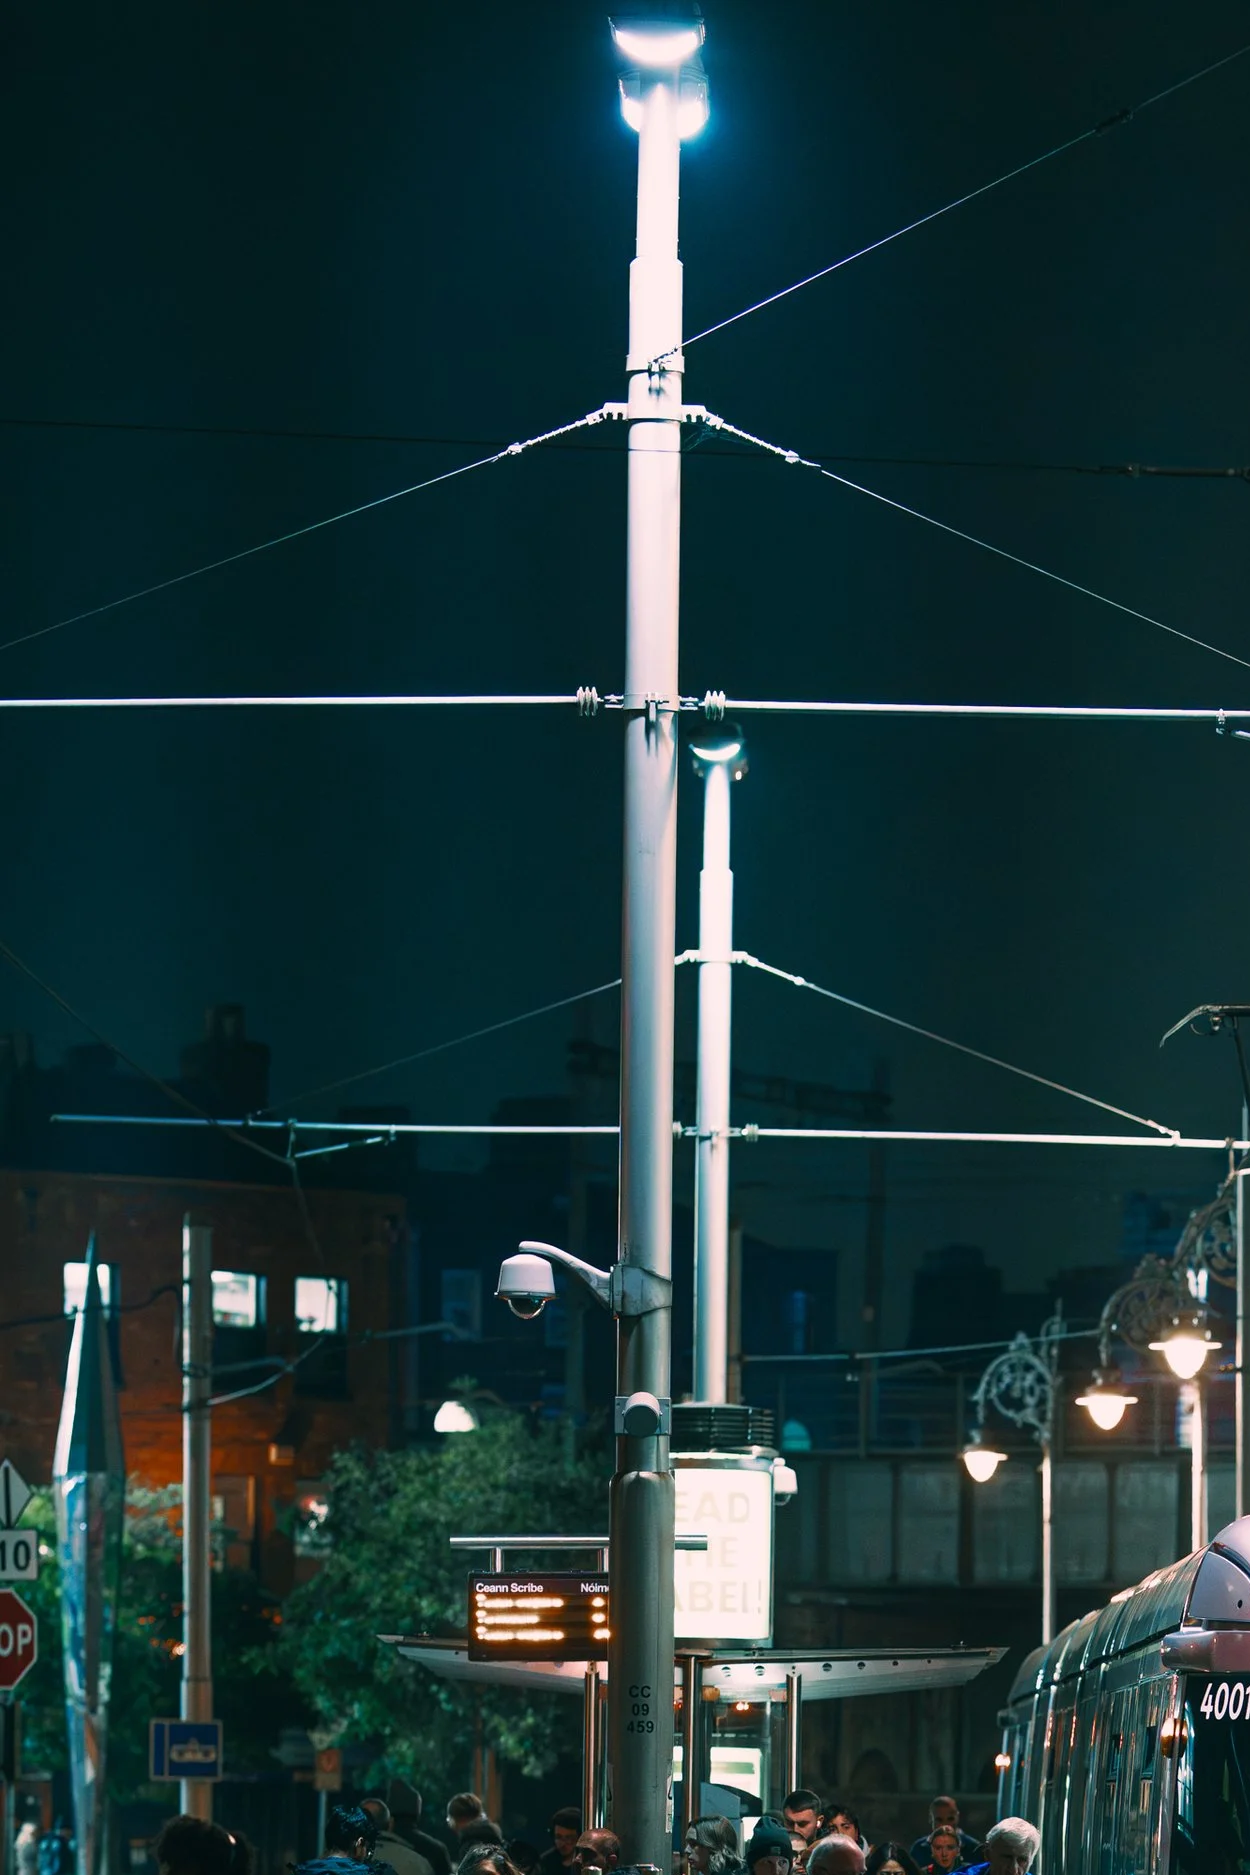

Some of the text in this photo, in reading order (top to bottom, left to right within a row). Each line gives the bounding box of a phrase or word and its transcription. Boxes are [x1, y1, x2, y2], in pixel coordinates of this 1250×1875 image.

[674, 1490, 751, 1524] EAD
[684, 1536, 739, 1568] HE
[475, 1583, 508, 1593] Ceann
[580, 1582, 609, 1593] Nóim
[674, 1579, 763, 1615] BEL!
[0, 1622, 32, 1658] OP
[629, 1685, 651, 1698] CC
[632, 1703, 650, 1717] 09
[627, 1720, 654, 1734] 459
